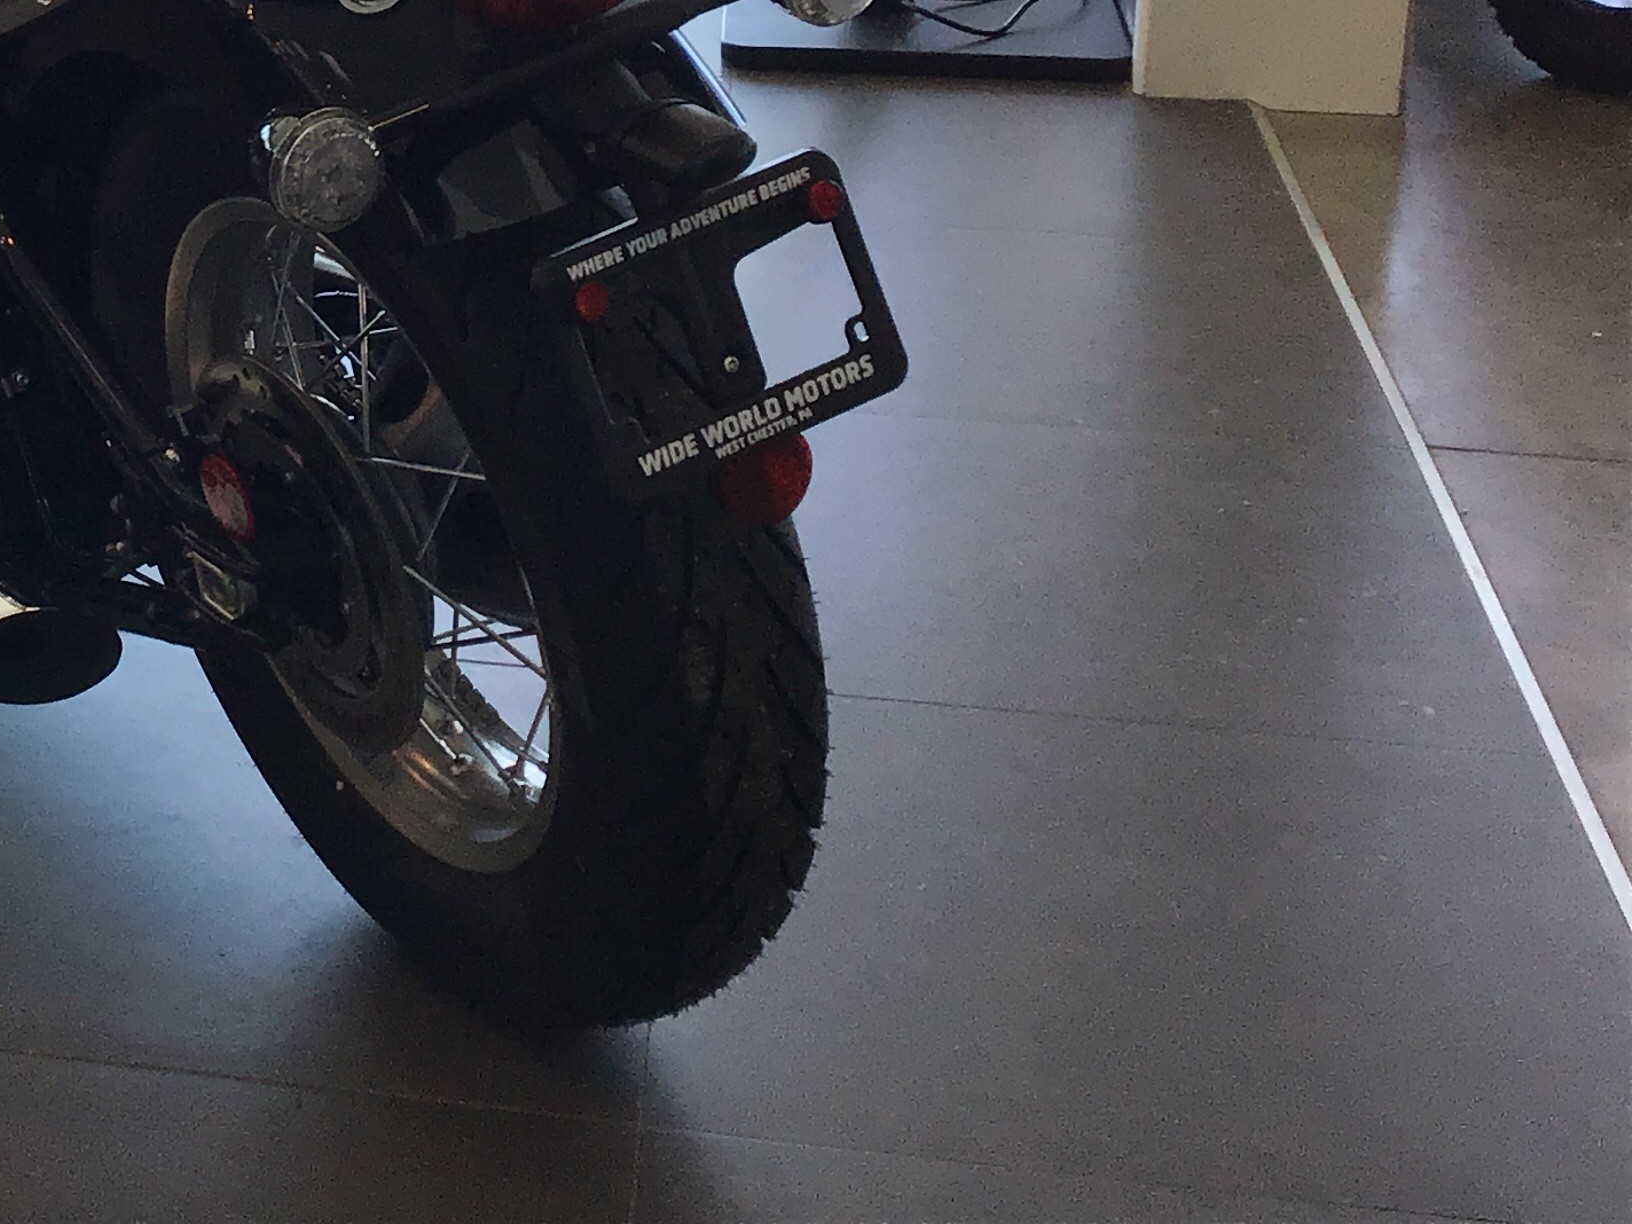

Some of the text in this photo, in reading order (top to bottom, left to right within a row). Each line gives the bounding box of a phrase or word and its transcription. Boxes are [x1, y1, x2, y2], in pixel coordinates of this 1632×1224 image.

[567, 166, 811, 282] WHERE YOUR ADVENTURE BEGINS
[638, 354, 875, 477] WIDE WORLD MOTORS
[714, 433, 747, 460] WEST
